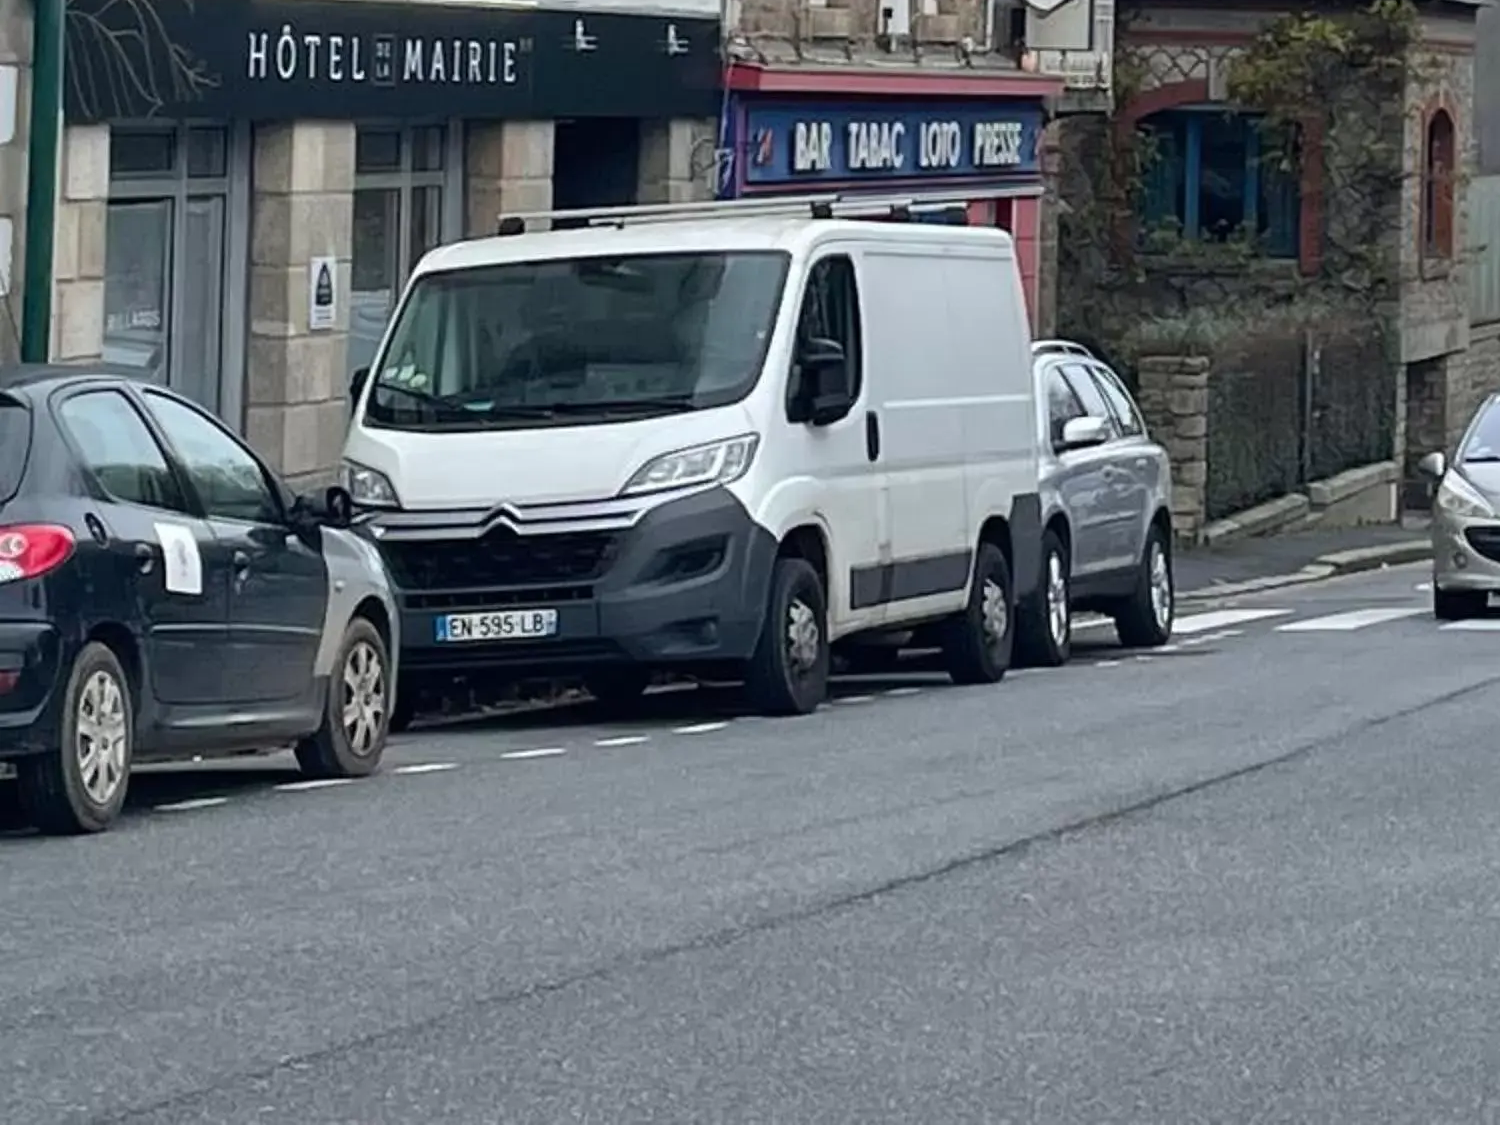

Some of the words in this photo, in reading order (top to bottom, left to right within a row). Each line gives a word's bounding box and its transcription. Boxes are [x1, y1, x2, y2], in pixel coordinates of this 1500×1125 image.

[249, 25, 365, 80] HÔTEL
[402, 38, 517, 83] MAIRIE
[794, 122, 833, 170] BAR
[847, 122, 905, 168] TABAC
[919, 121, 961, 168] LOTO
[973, 122, 1022, 166] PRESSE
